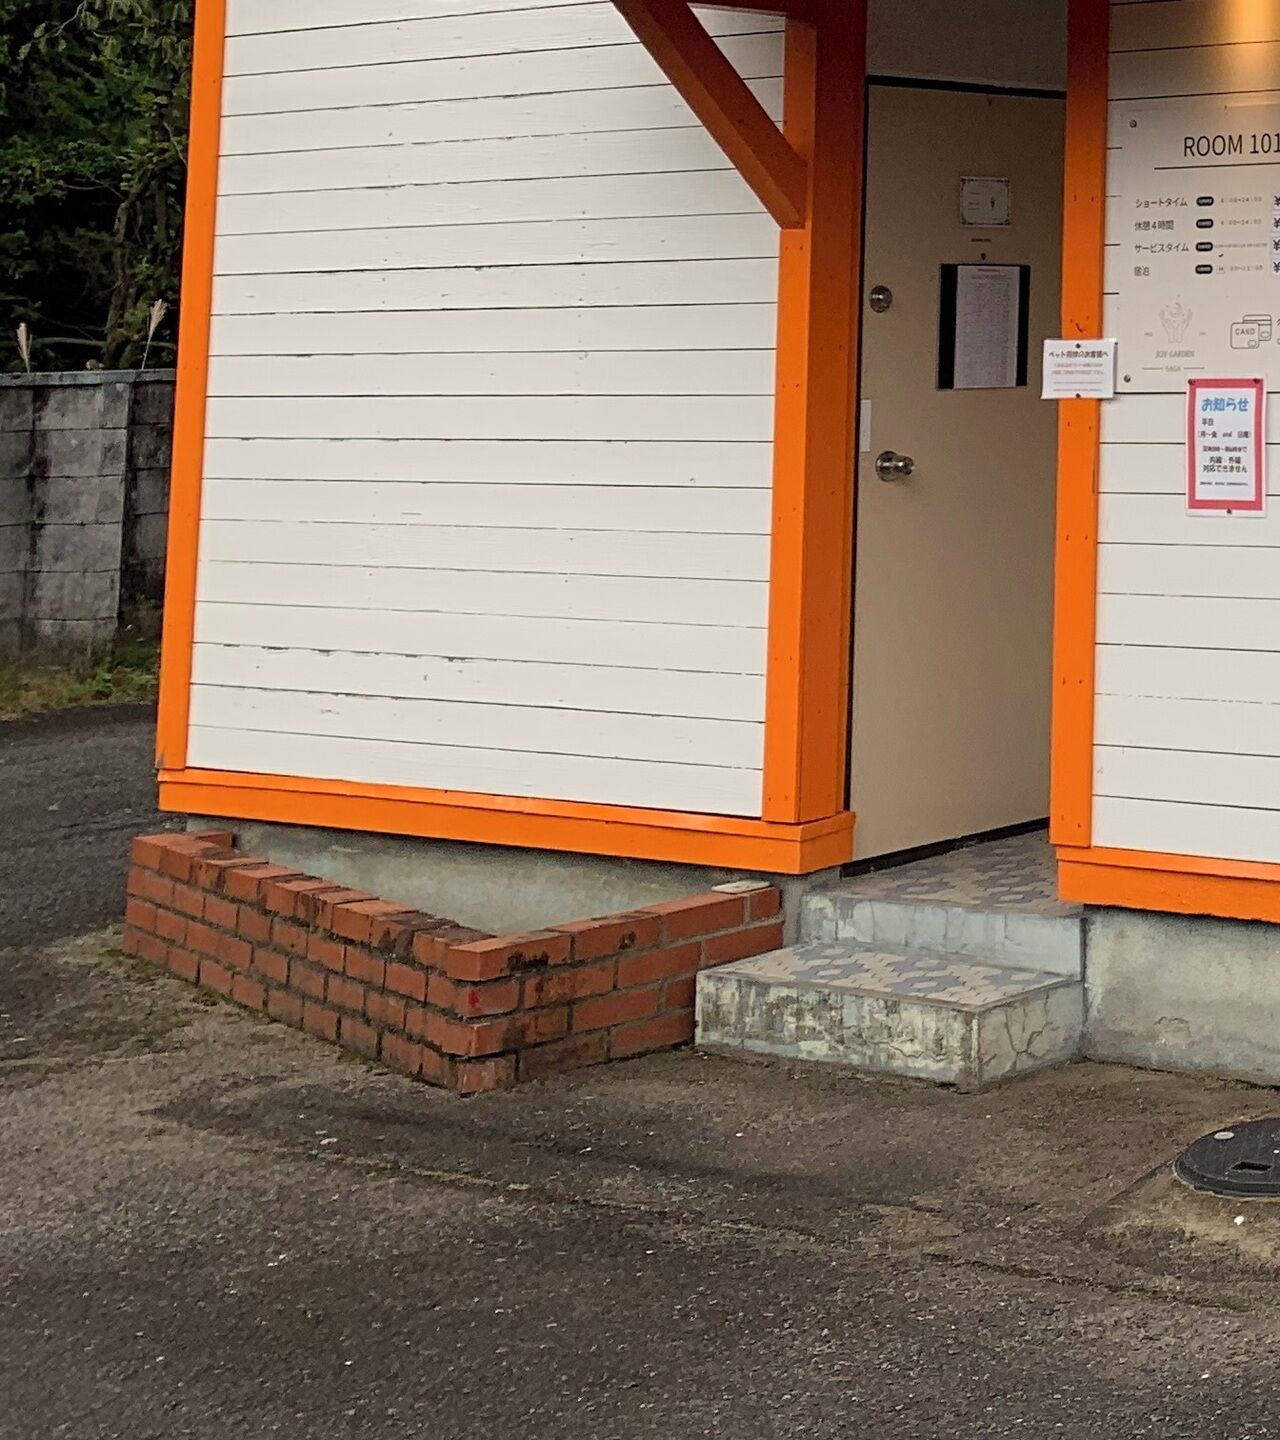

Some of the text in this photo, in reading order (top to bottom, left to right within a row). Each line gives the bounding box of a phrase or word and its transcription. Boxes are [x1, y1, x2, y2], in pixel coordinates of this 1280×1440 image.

[1183, 134, 1243, 157] ROOM
[1135, 197, 1188, 209] ショートタイム
[1134, 242, 1190, 254] サービスタイム
[1201, 397, 1249, 412] お知らせ
